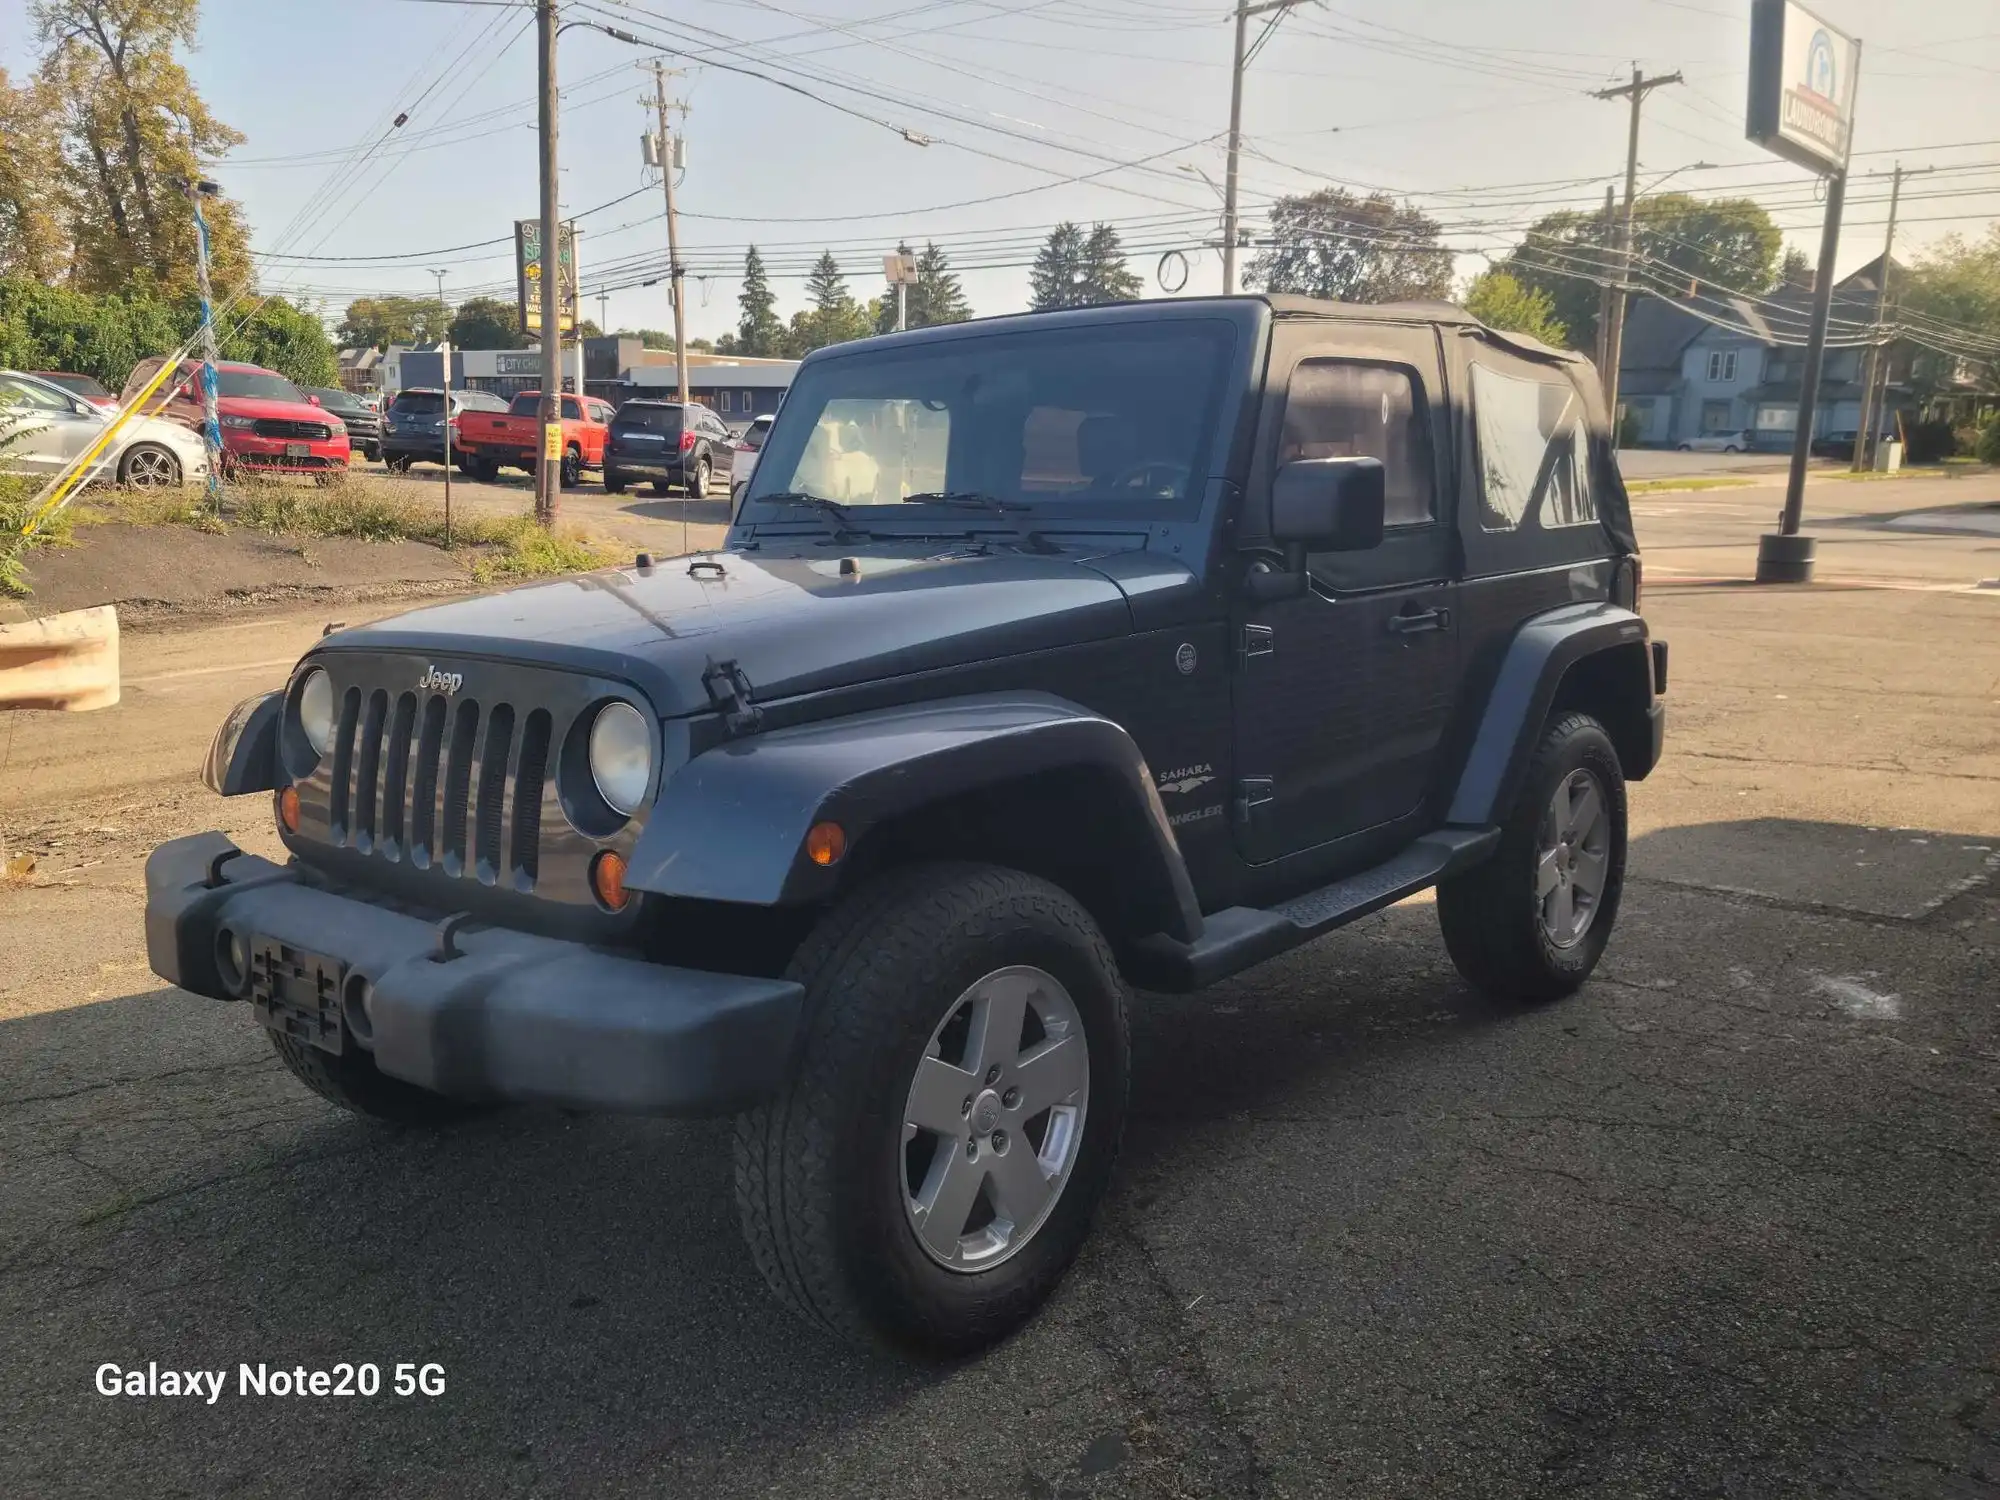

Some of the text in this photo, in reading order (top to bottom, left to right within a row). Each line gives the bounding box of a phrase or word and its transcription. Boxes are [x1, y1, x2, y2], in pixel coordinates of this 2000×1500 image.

[505, 358, 522, 371] CITY
[420, 665, 463, 696] Jeep
[1160, 763, 1212, 781] SAHARA
[1168, 805, 1223, 825] ANGLER
